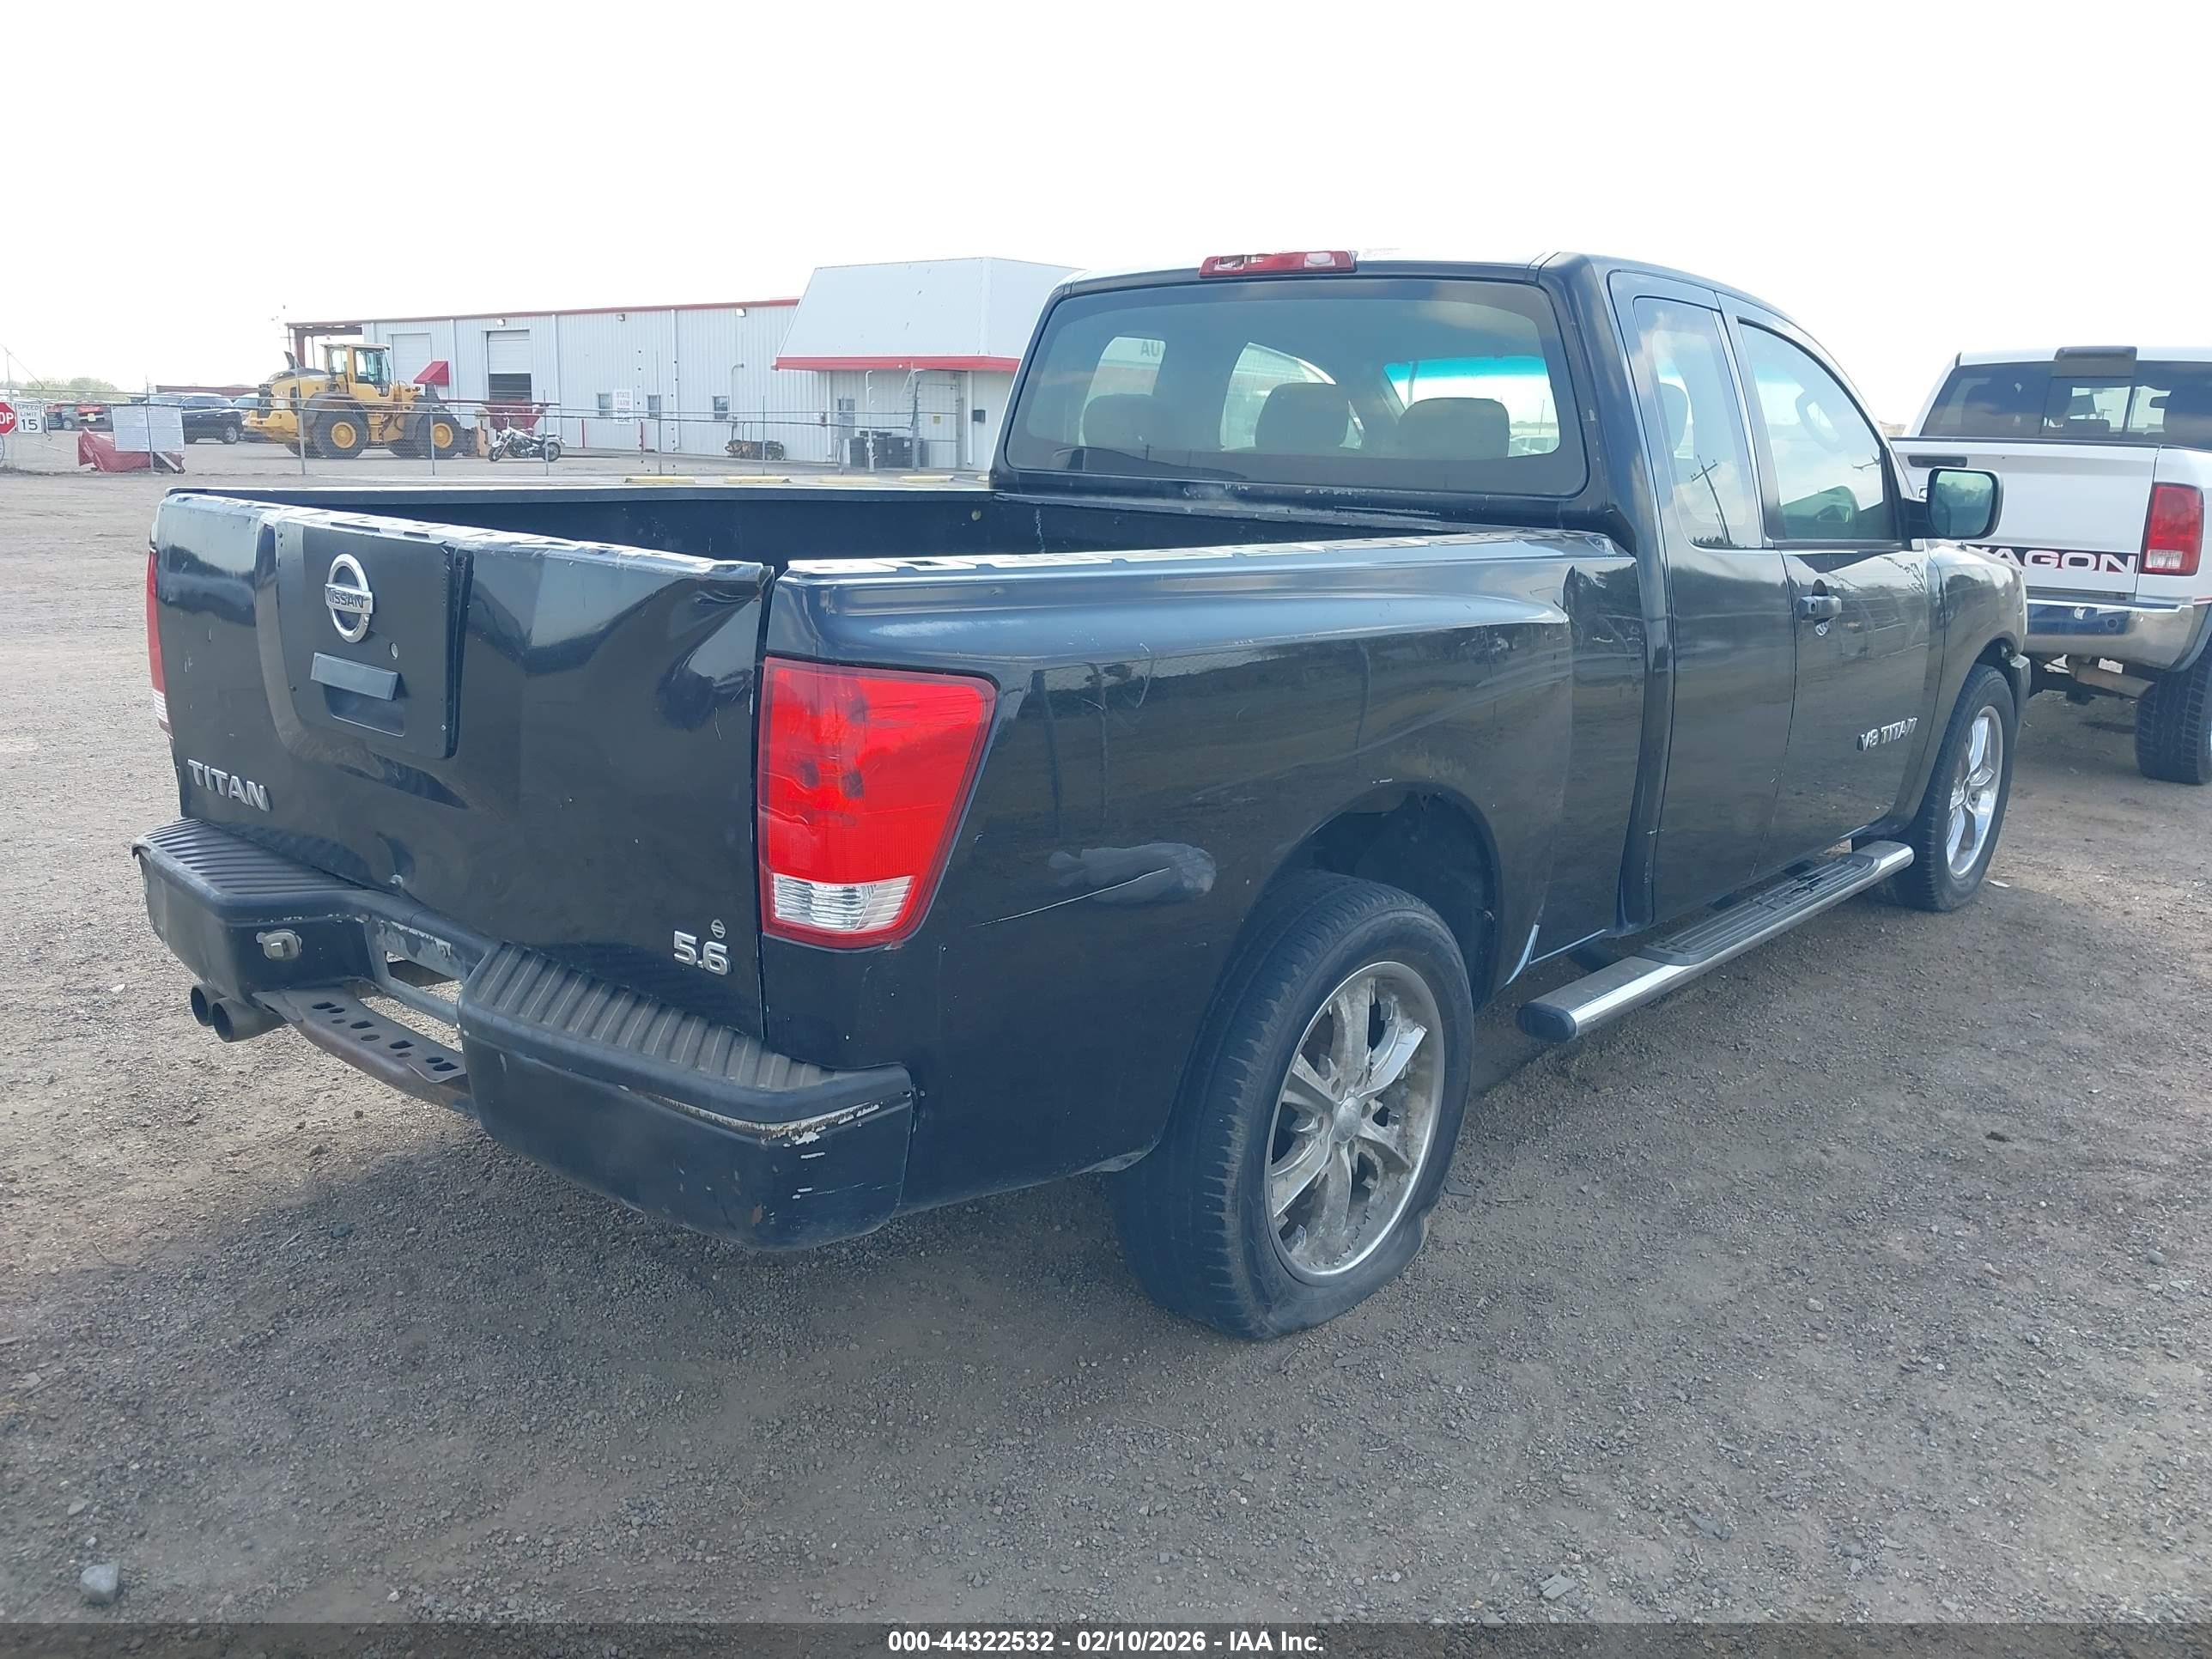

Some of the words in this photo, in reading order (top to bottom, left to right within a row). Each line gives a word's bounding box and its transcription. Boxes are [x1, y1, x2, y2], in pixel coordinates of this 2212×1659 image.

[21, 418, 38, 430] 15
[1979, 546, 2136, 574] AGON
[326, 586, 364, 609] NISSAN
[1860, 728, 1878, 750] V8
[1881, 717, 1918, 744] TITAN
[187, 758, 270, 811] TITAN
[673, 930, 731, 976] 5.6
